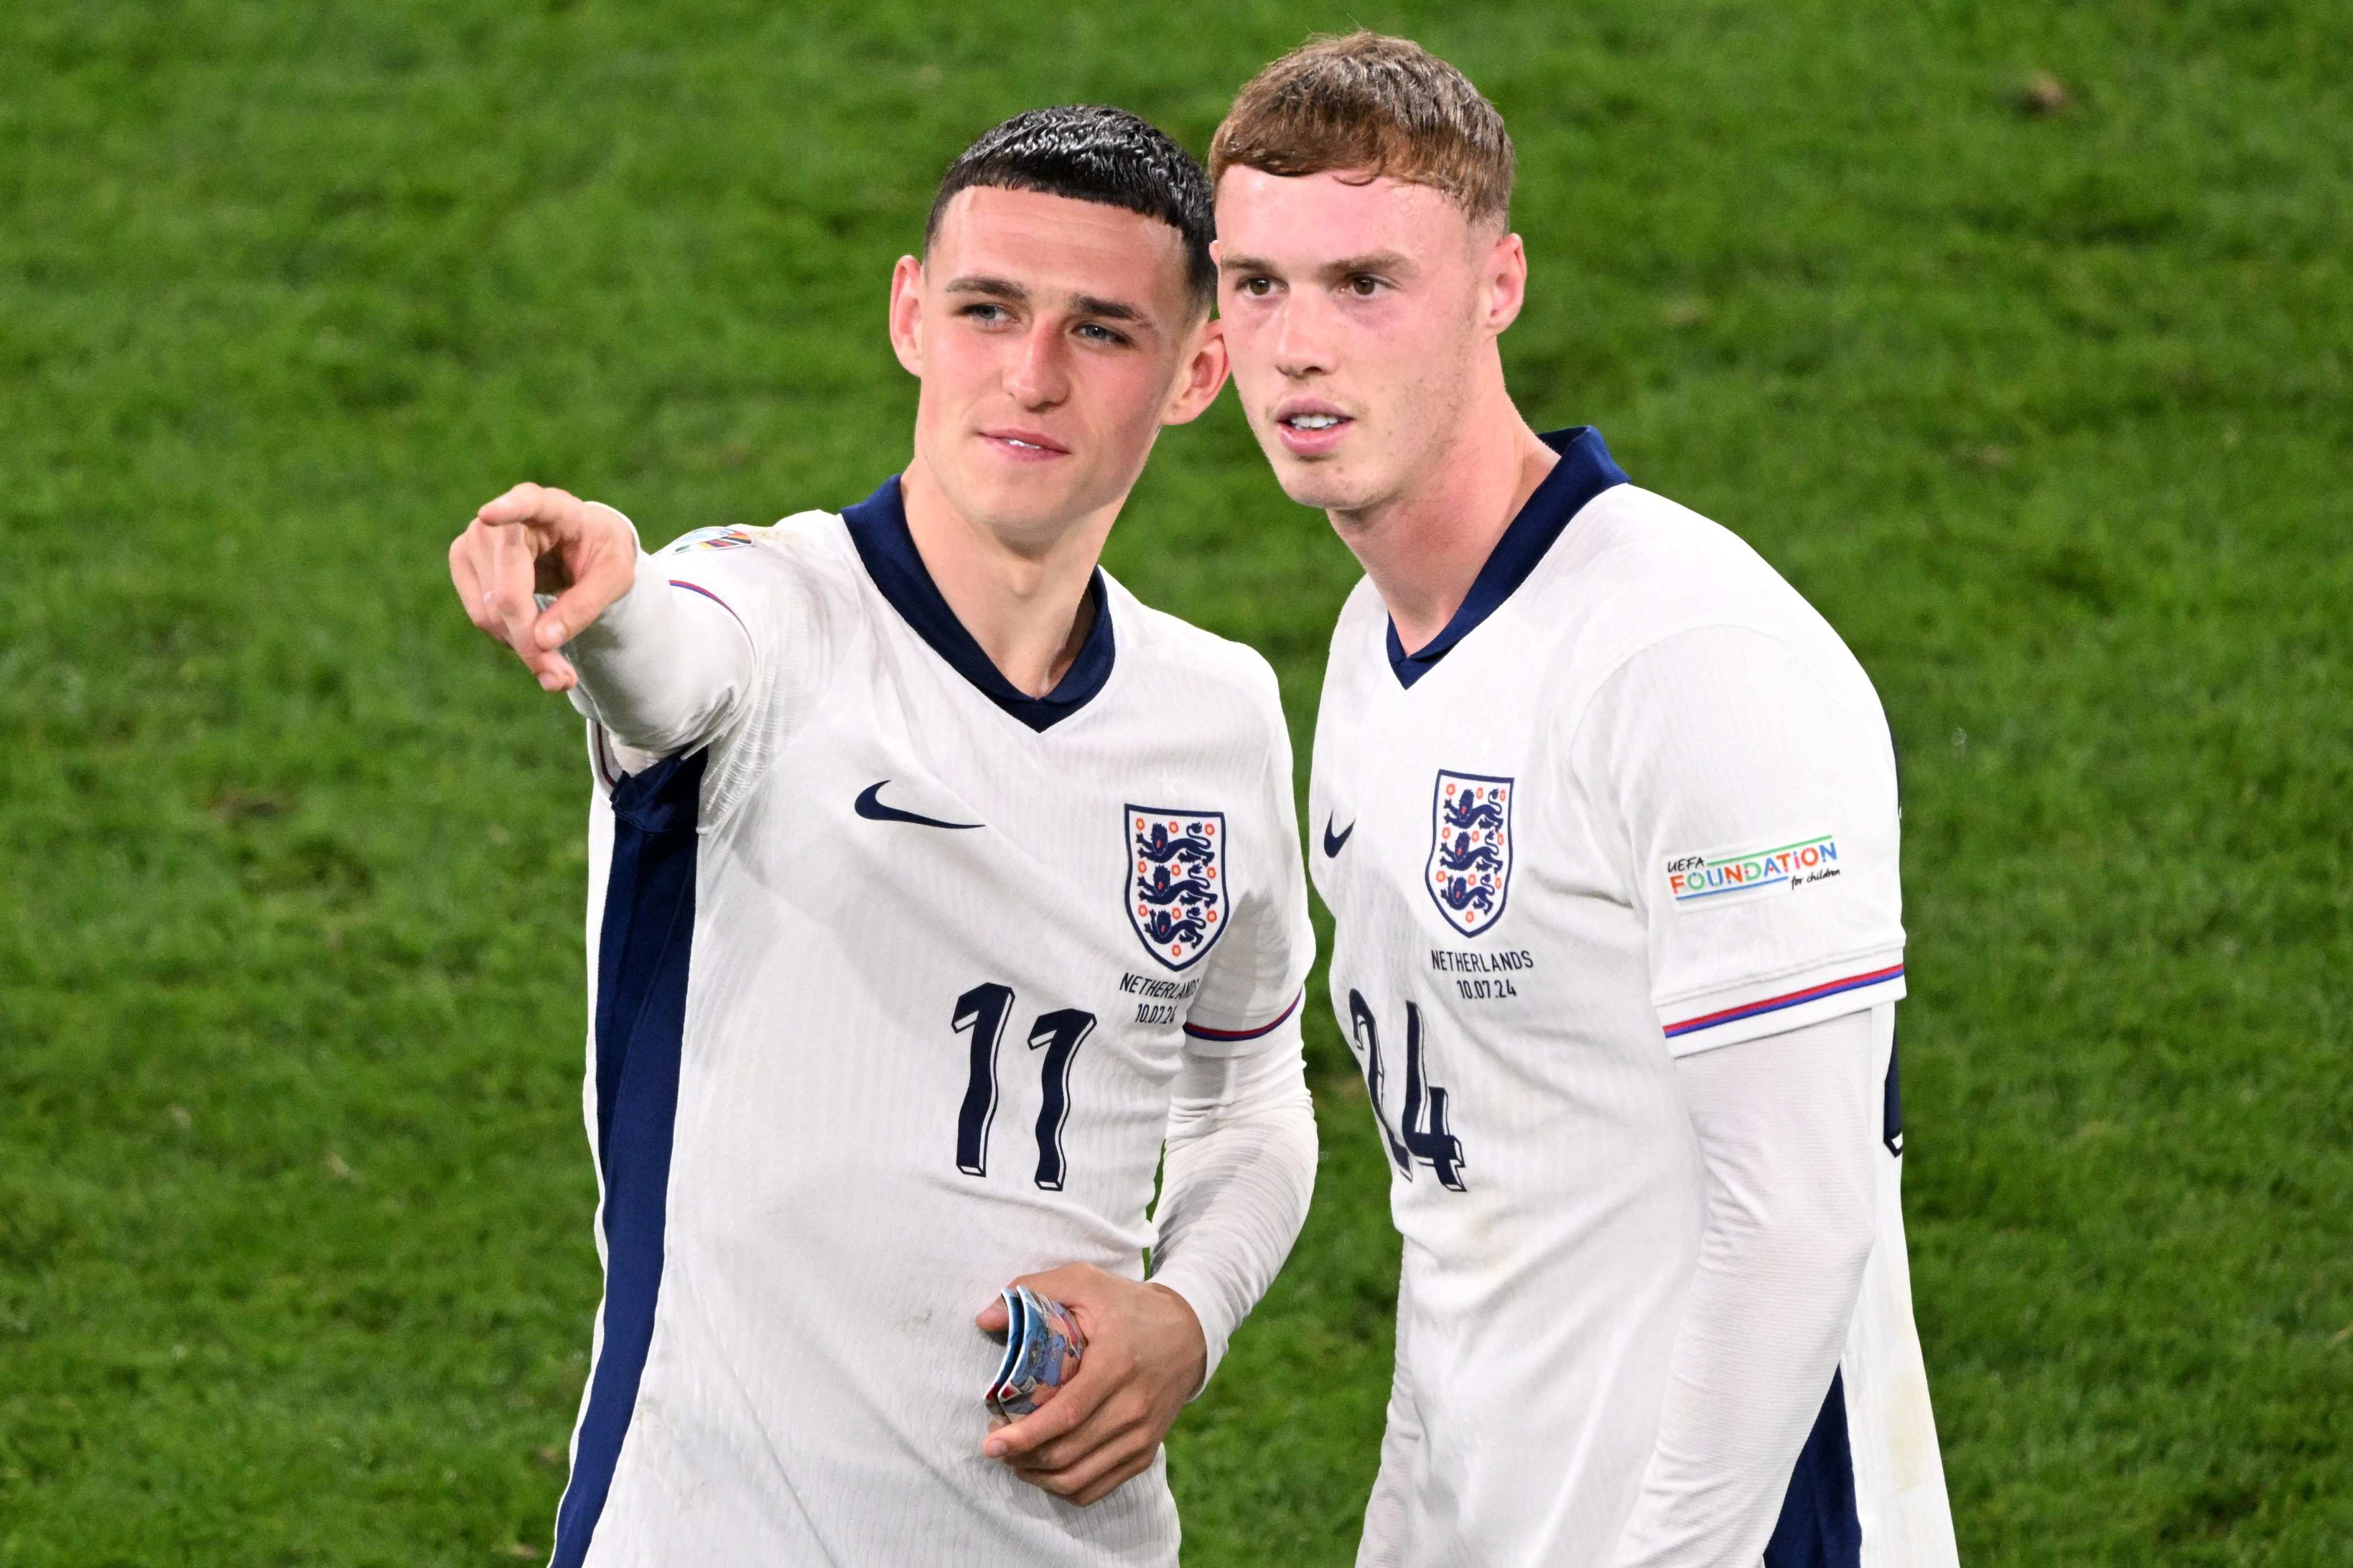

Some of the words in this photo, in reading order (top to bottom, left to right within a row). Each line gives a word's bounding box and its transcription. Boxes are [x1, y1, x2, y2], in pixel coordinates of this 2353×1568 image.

[1667, 856, 1705, 873] UEFA
[1791, 875, 1803, 891] for
[1806, 867, 1841, 883] children
[1430, 949, 1534, 972] NETHERLANDS
[1119, 972, 1199, 999] NETHERLAND
[1456, 979, 1517, 999] 10.07.24
[1135, 1003, 1178, 1025] 10.07.24
[951, 982, 1097, 1192] 11
[1349, 988, 1468, 1192] 24
